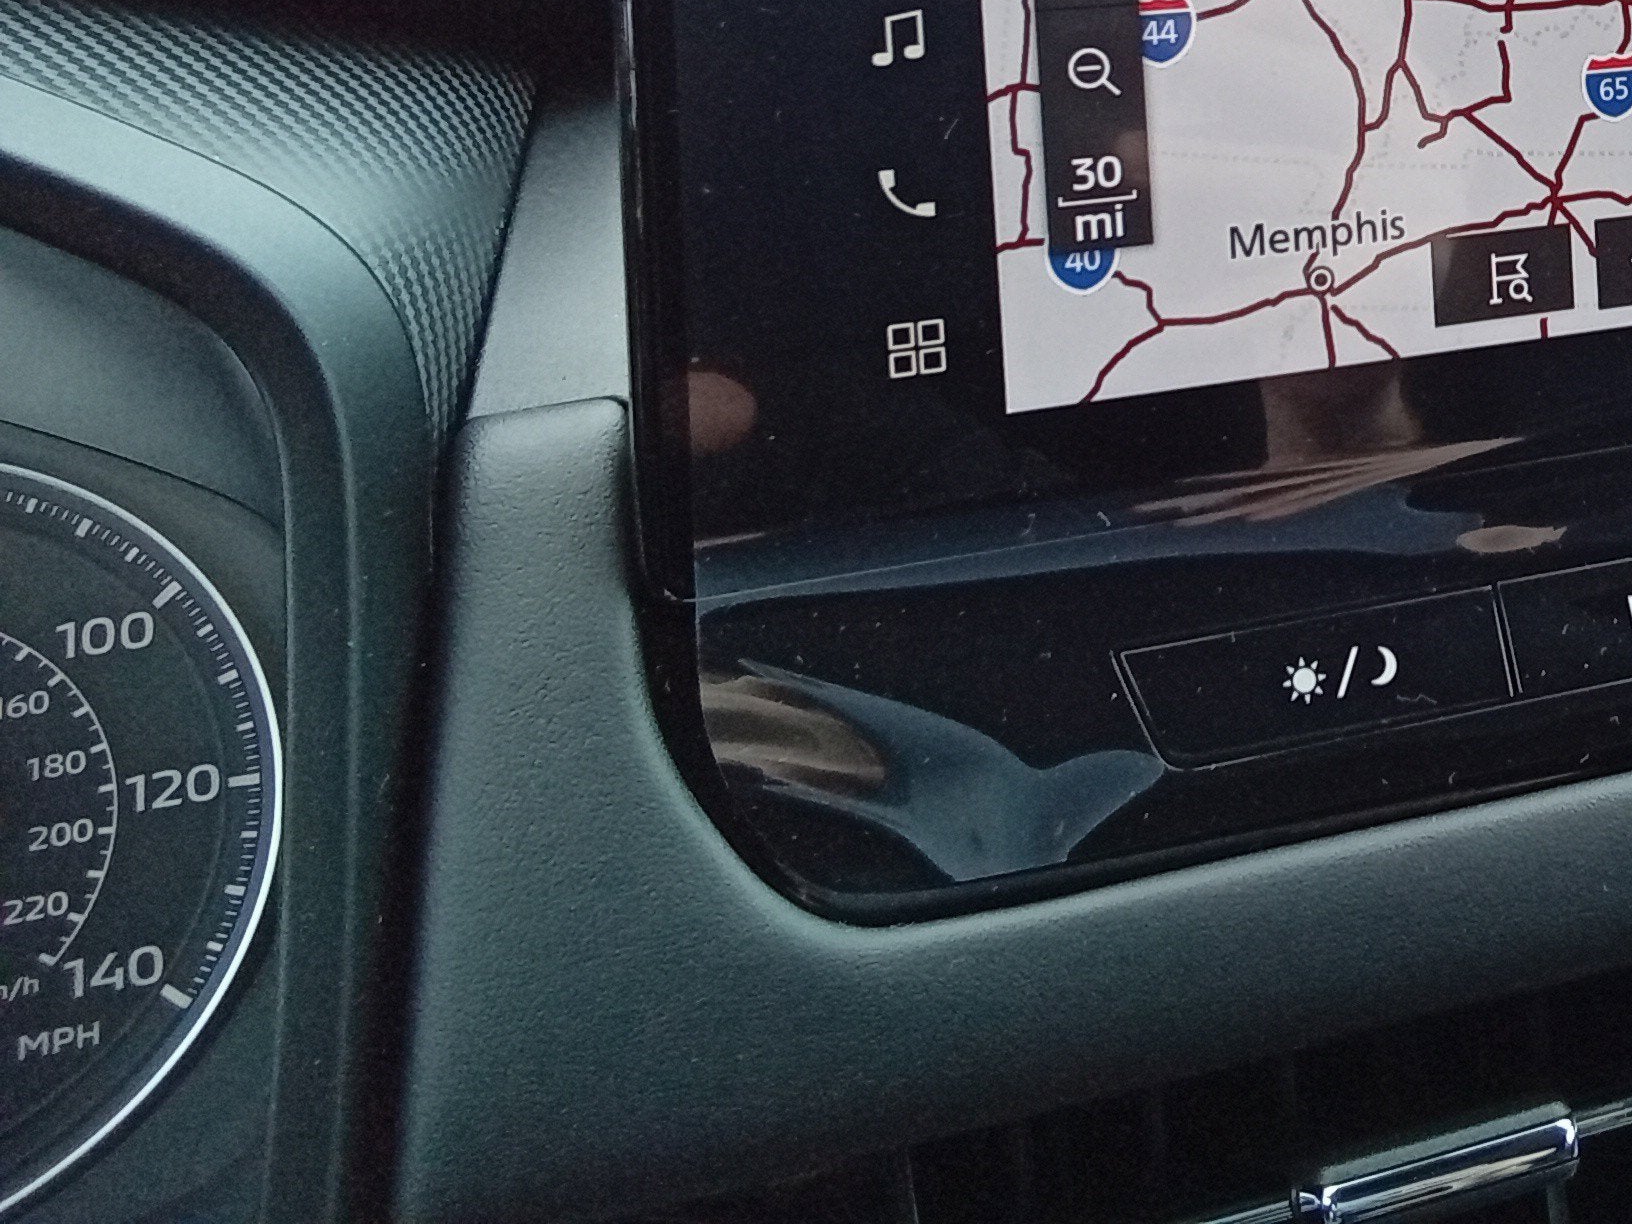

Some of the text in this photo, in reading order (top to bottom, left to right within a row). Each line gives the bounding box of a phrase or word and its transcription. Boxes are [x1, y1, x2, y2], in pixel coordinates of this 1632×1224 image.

[1142, 19, 1179, 44] 44
[1599, 77, 1629, 101] 65
[1071, 155, 1122, 190] 30
[1074, 204, 1125, 244] mi
[1229, 210, 1406, 259] Memphis
[1064, 250, 1101, 273] 40
[55, 610, 155, 659] 100
[26, 750, 87, 782] 180
[126, 762, 222, 814] 120
[28, 818, 94, 852] 200
[2, 890, 69, 926] 220
[63, 944, 165, 999] 140
[18, 1020, 101, 1062] MPH
